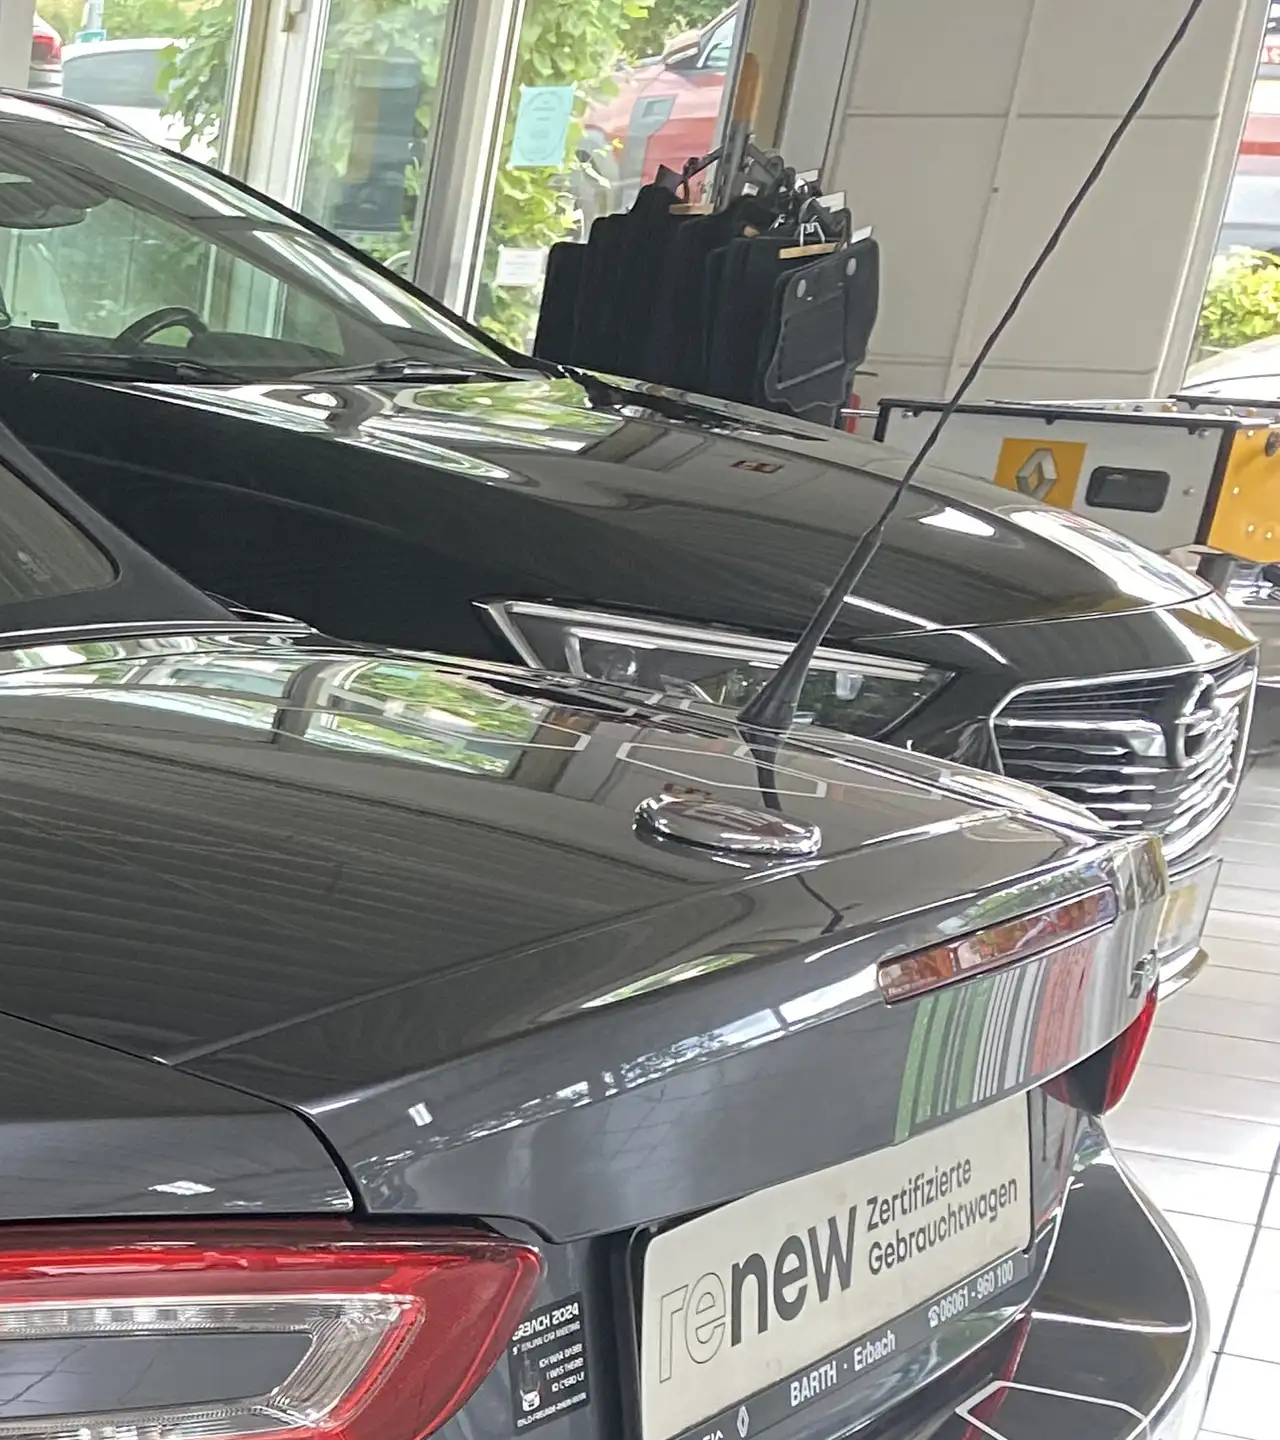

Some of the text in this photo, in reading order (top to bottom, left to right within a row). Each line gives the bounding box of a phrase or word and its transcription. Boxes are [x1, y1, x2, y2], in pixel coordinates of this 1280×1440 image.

[866, 1158, 971, 1233] Zertifizierte
[868, 1178, 1018, 1275] Gebrauchtwagen
[543, 1331, 555, 1343] CAR
[552, 1302, 579, 1325] 2024
[659, 1204, 857, 1384] renew
[790, 1361, 837, 1407] BARTH
[853, 1330, 896, 1371] Erbach
[940, 1286, 969, 1322] 06061
[977, 1270, 995, 1299] 960
[996, 1260, 1014, 1287] 100
